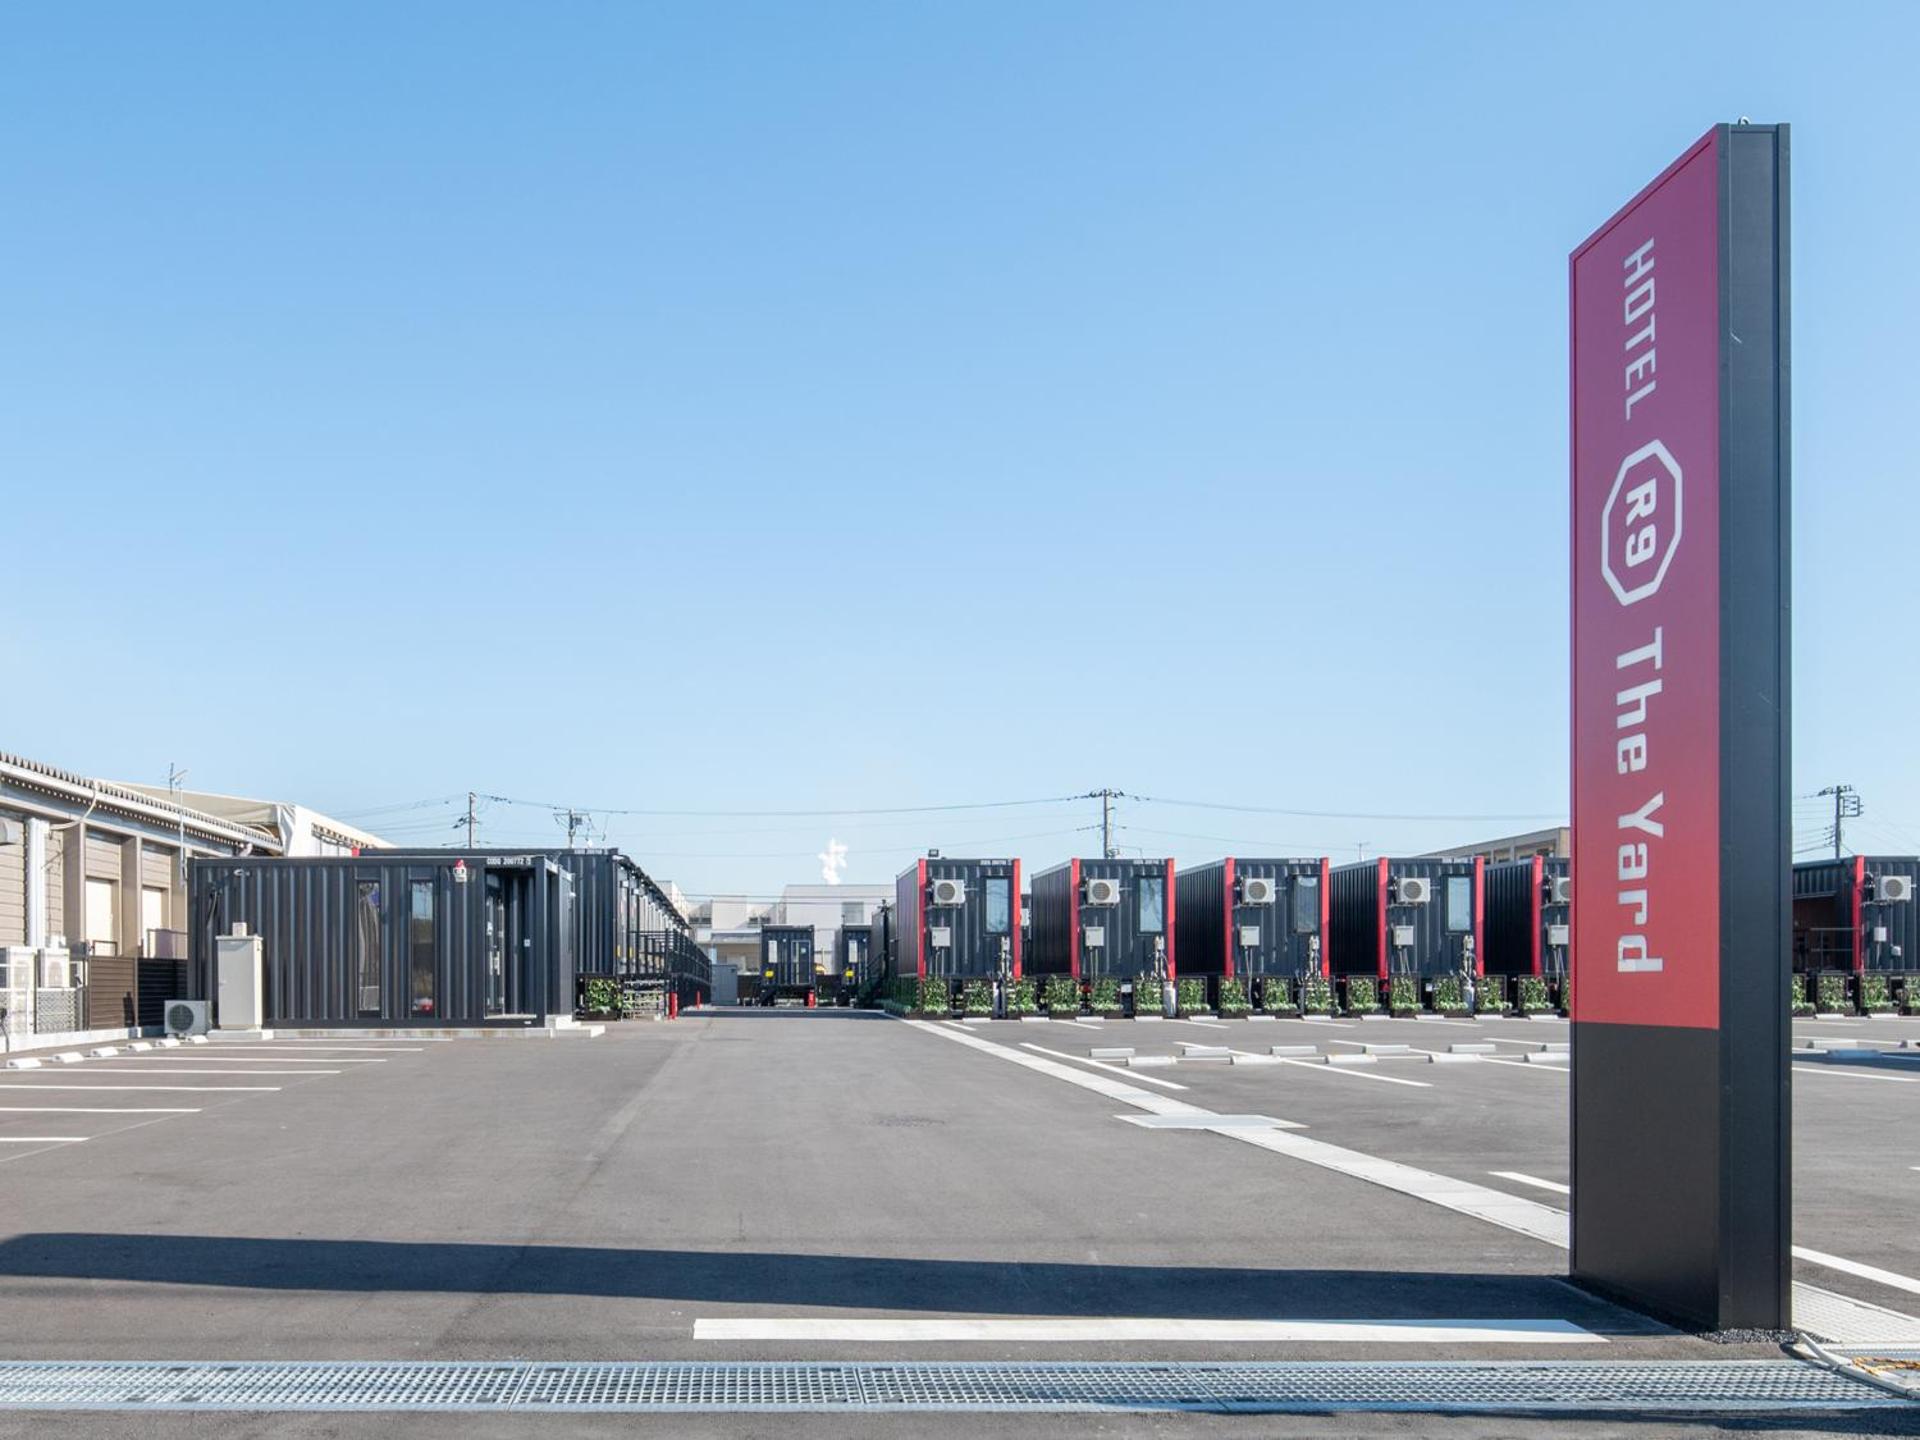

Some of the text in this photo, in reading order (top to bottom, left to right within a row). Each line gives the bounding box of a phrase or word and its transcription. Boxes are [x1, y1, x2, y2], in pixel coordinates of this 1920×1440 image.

[1616, 237, 1664, 973] HOTEL R9 The Yard
